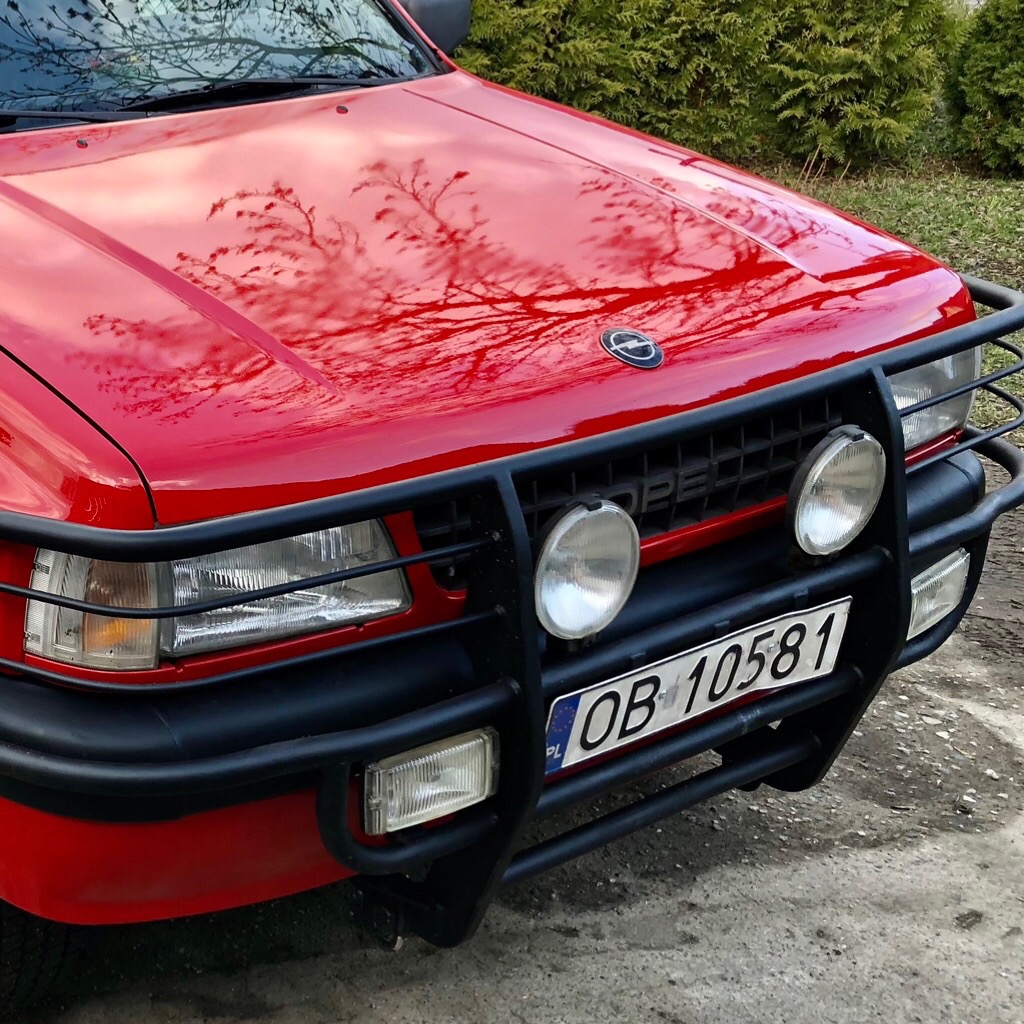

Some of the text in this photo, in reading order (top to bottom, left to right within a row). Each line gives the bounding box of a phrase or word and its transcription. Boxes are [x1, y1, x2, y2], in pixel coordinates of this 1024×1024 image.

[579, 612, 836, 752] OB 10581
[546, 742, 562, 760] PL
